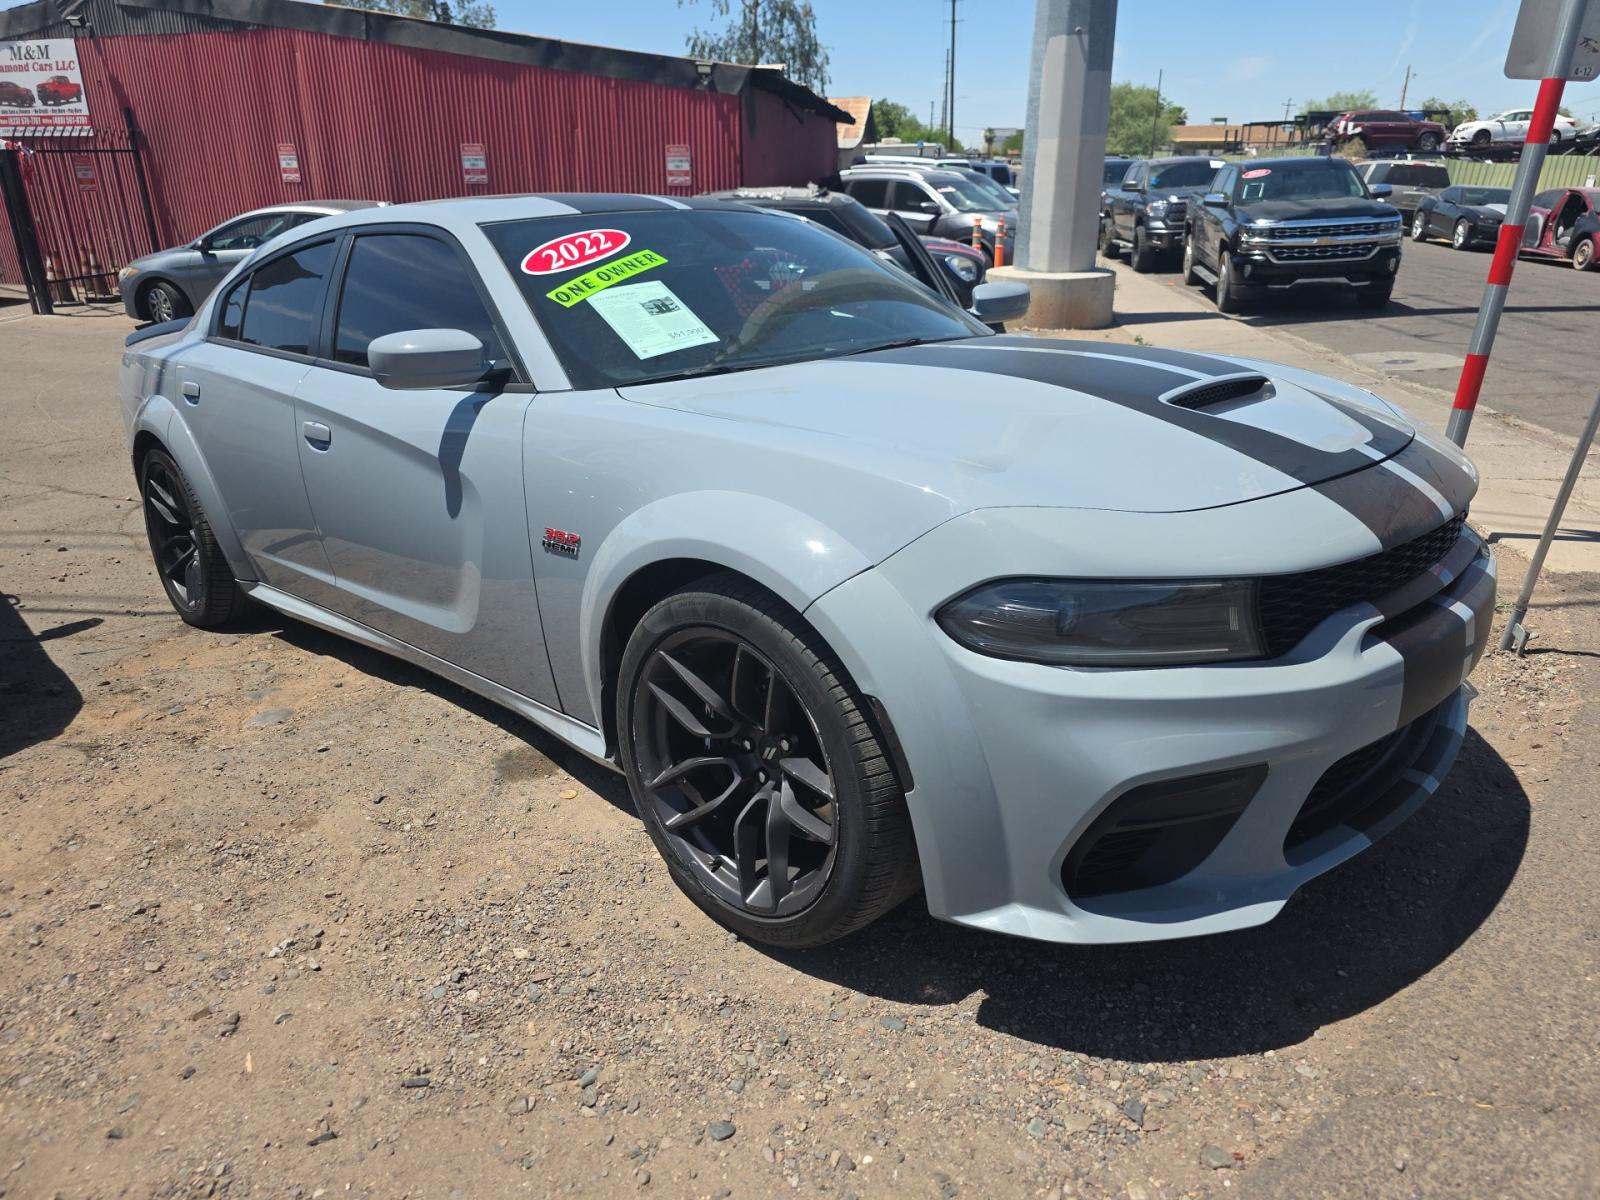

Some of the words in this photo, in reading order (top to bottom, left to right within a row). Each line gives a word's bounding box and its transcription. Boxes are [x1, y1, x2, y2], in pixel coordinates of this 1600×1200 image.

[10, 45, 50, 60] M&M
[32, 61, 53, 71] Cars
[55, 60, 75, 71] LLC
[542, 232, 612, 269] 2022
[555, 278, 595, 302] ONE
[596, 253, 658, 281] OWNER
[542, 539, 577, 555] HEMI
